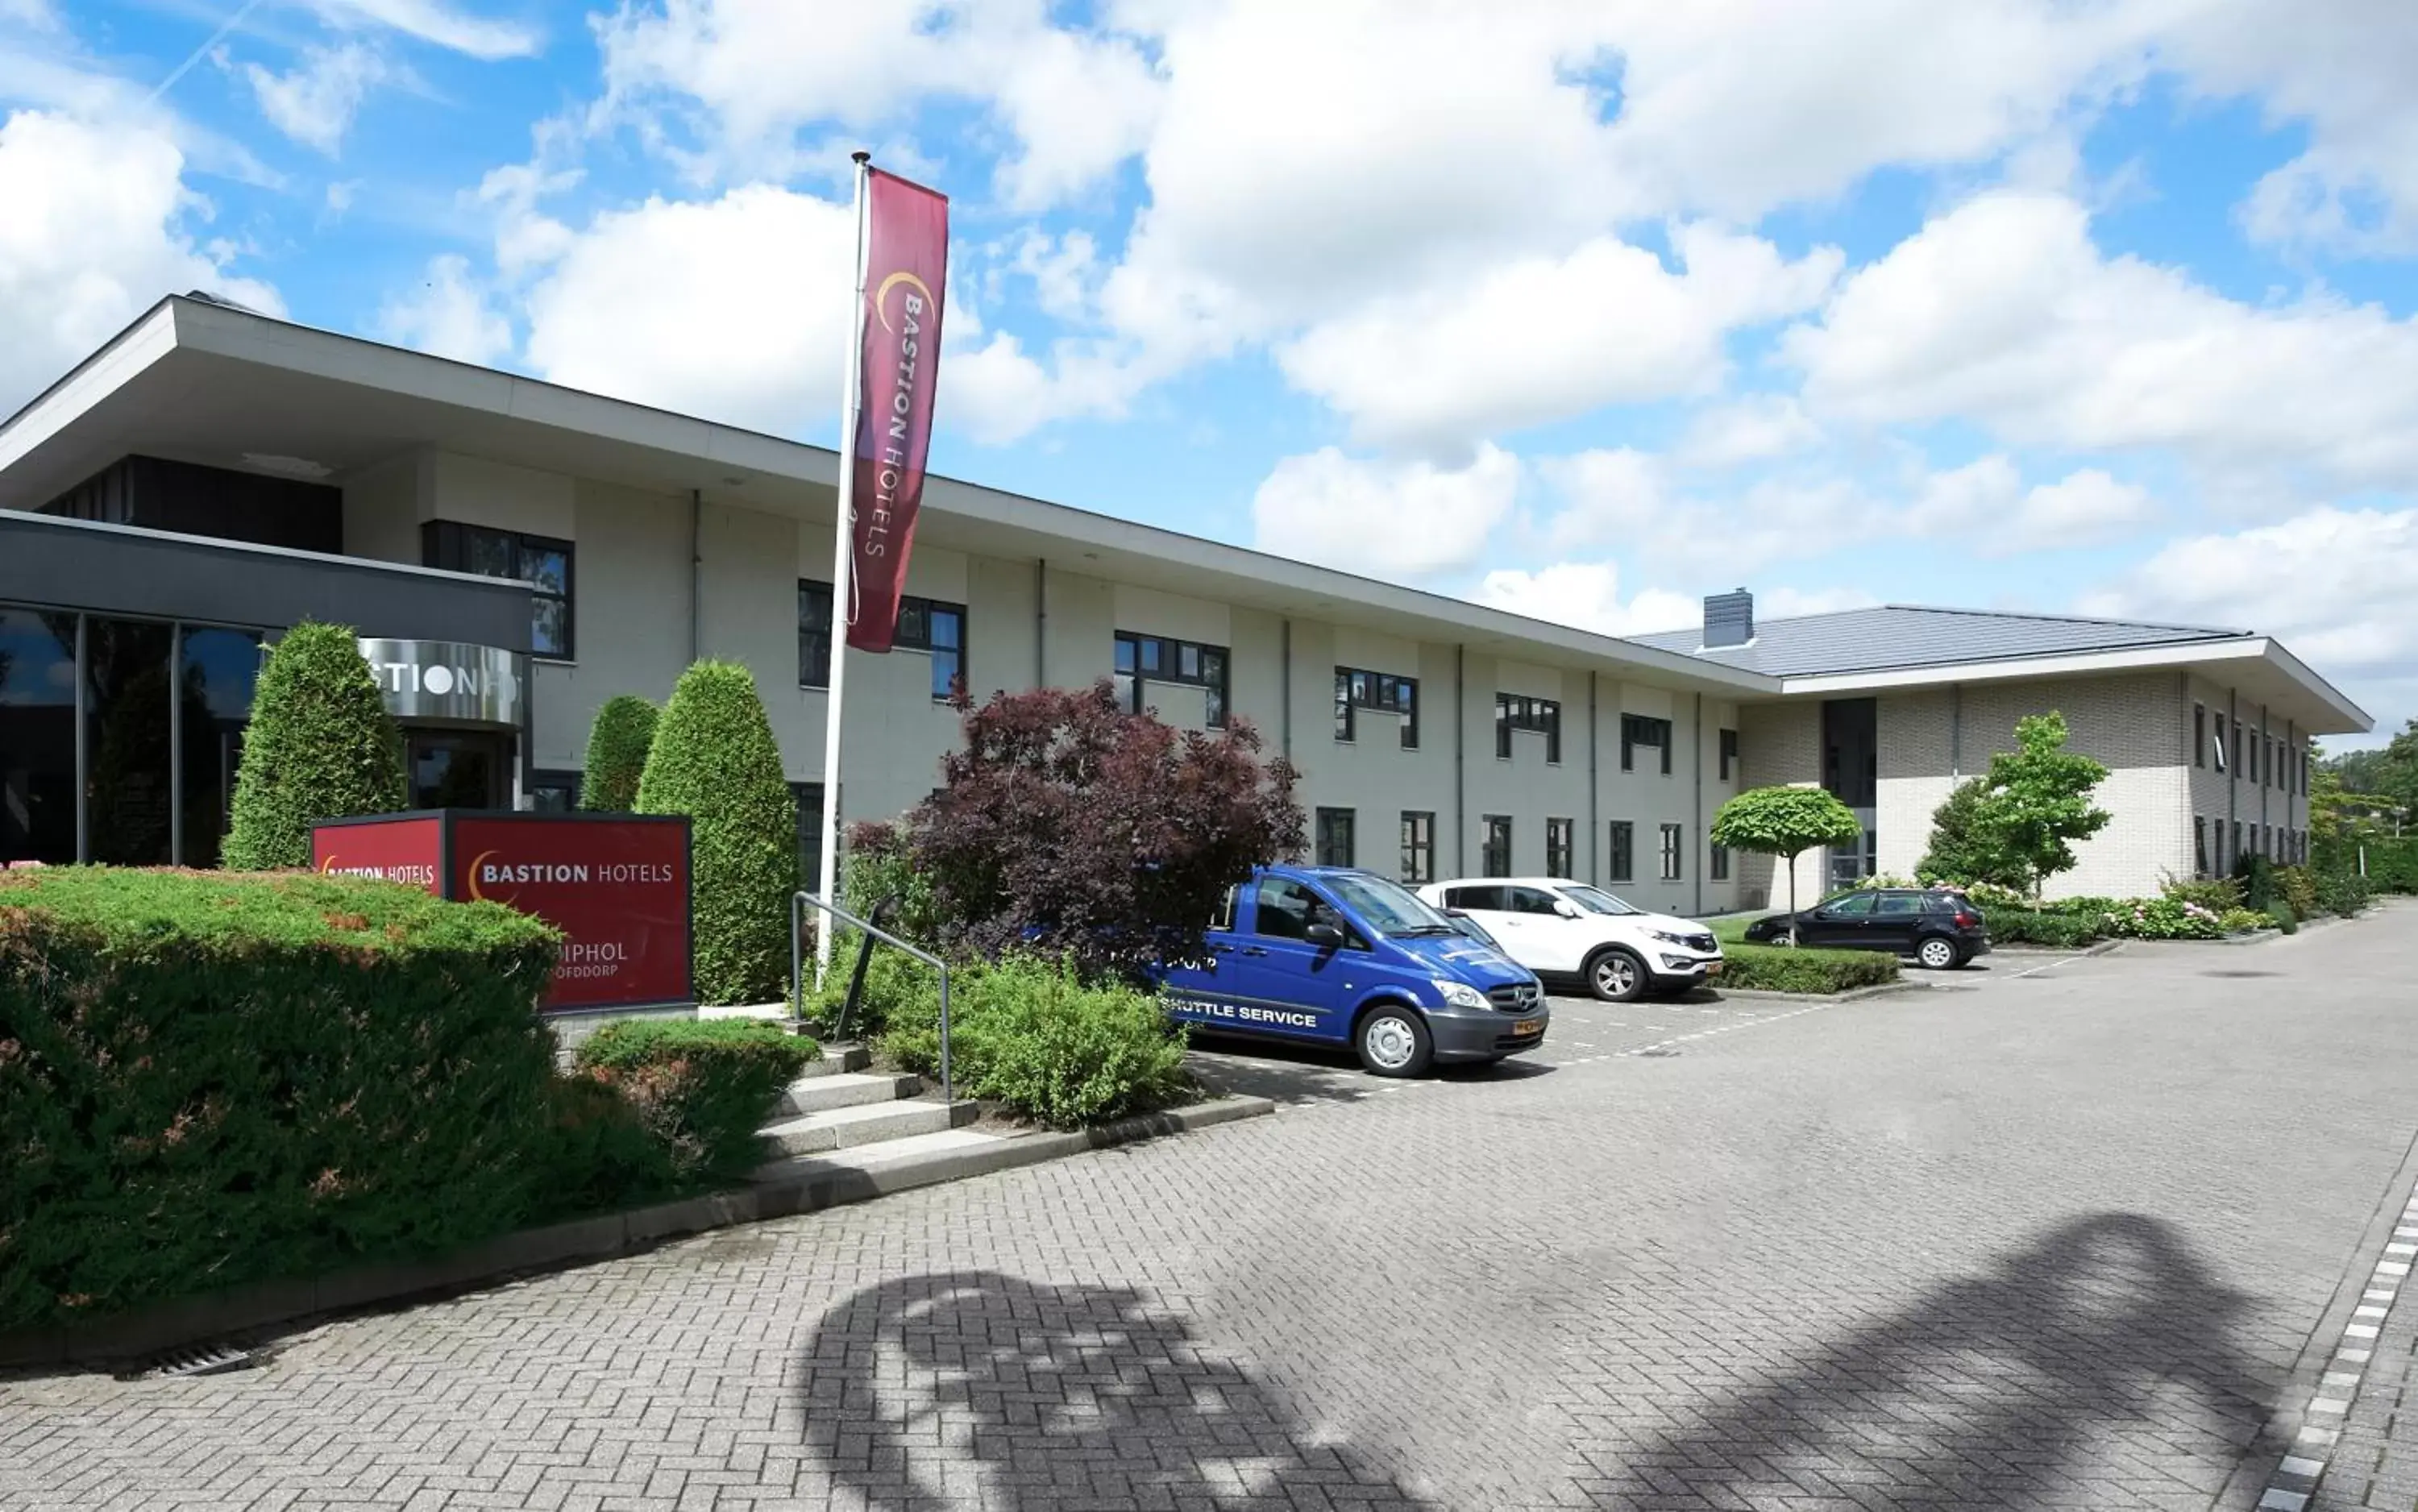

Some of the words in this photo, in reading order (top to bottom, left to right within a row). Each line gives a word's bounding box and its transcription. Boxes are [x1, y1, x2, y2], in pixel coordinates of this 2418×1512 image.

[889, 293, 923, 440] BASTION
[865, 447, 903, 557] HOTELS
[369, 663, 478, 696] STION
[388, 865, 434, 884] HOTELS
[484, 865, 588, 883] BASTION
[599, 864, 673, 883] HOTELS
[558, 942, 628, 962] IPHOL
[555, 965, 618, 979] OFDDORP
[1160, 998, 1235, 1017] SHUTTLE
[1239, 1007, 1317, 1028] SERVICE
